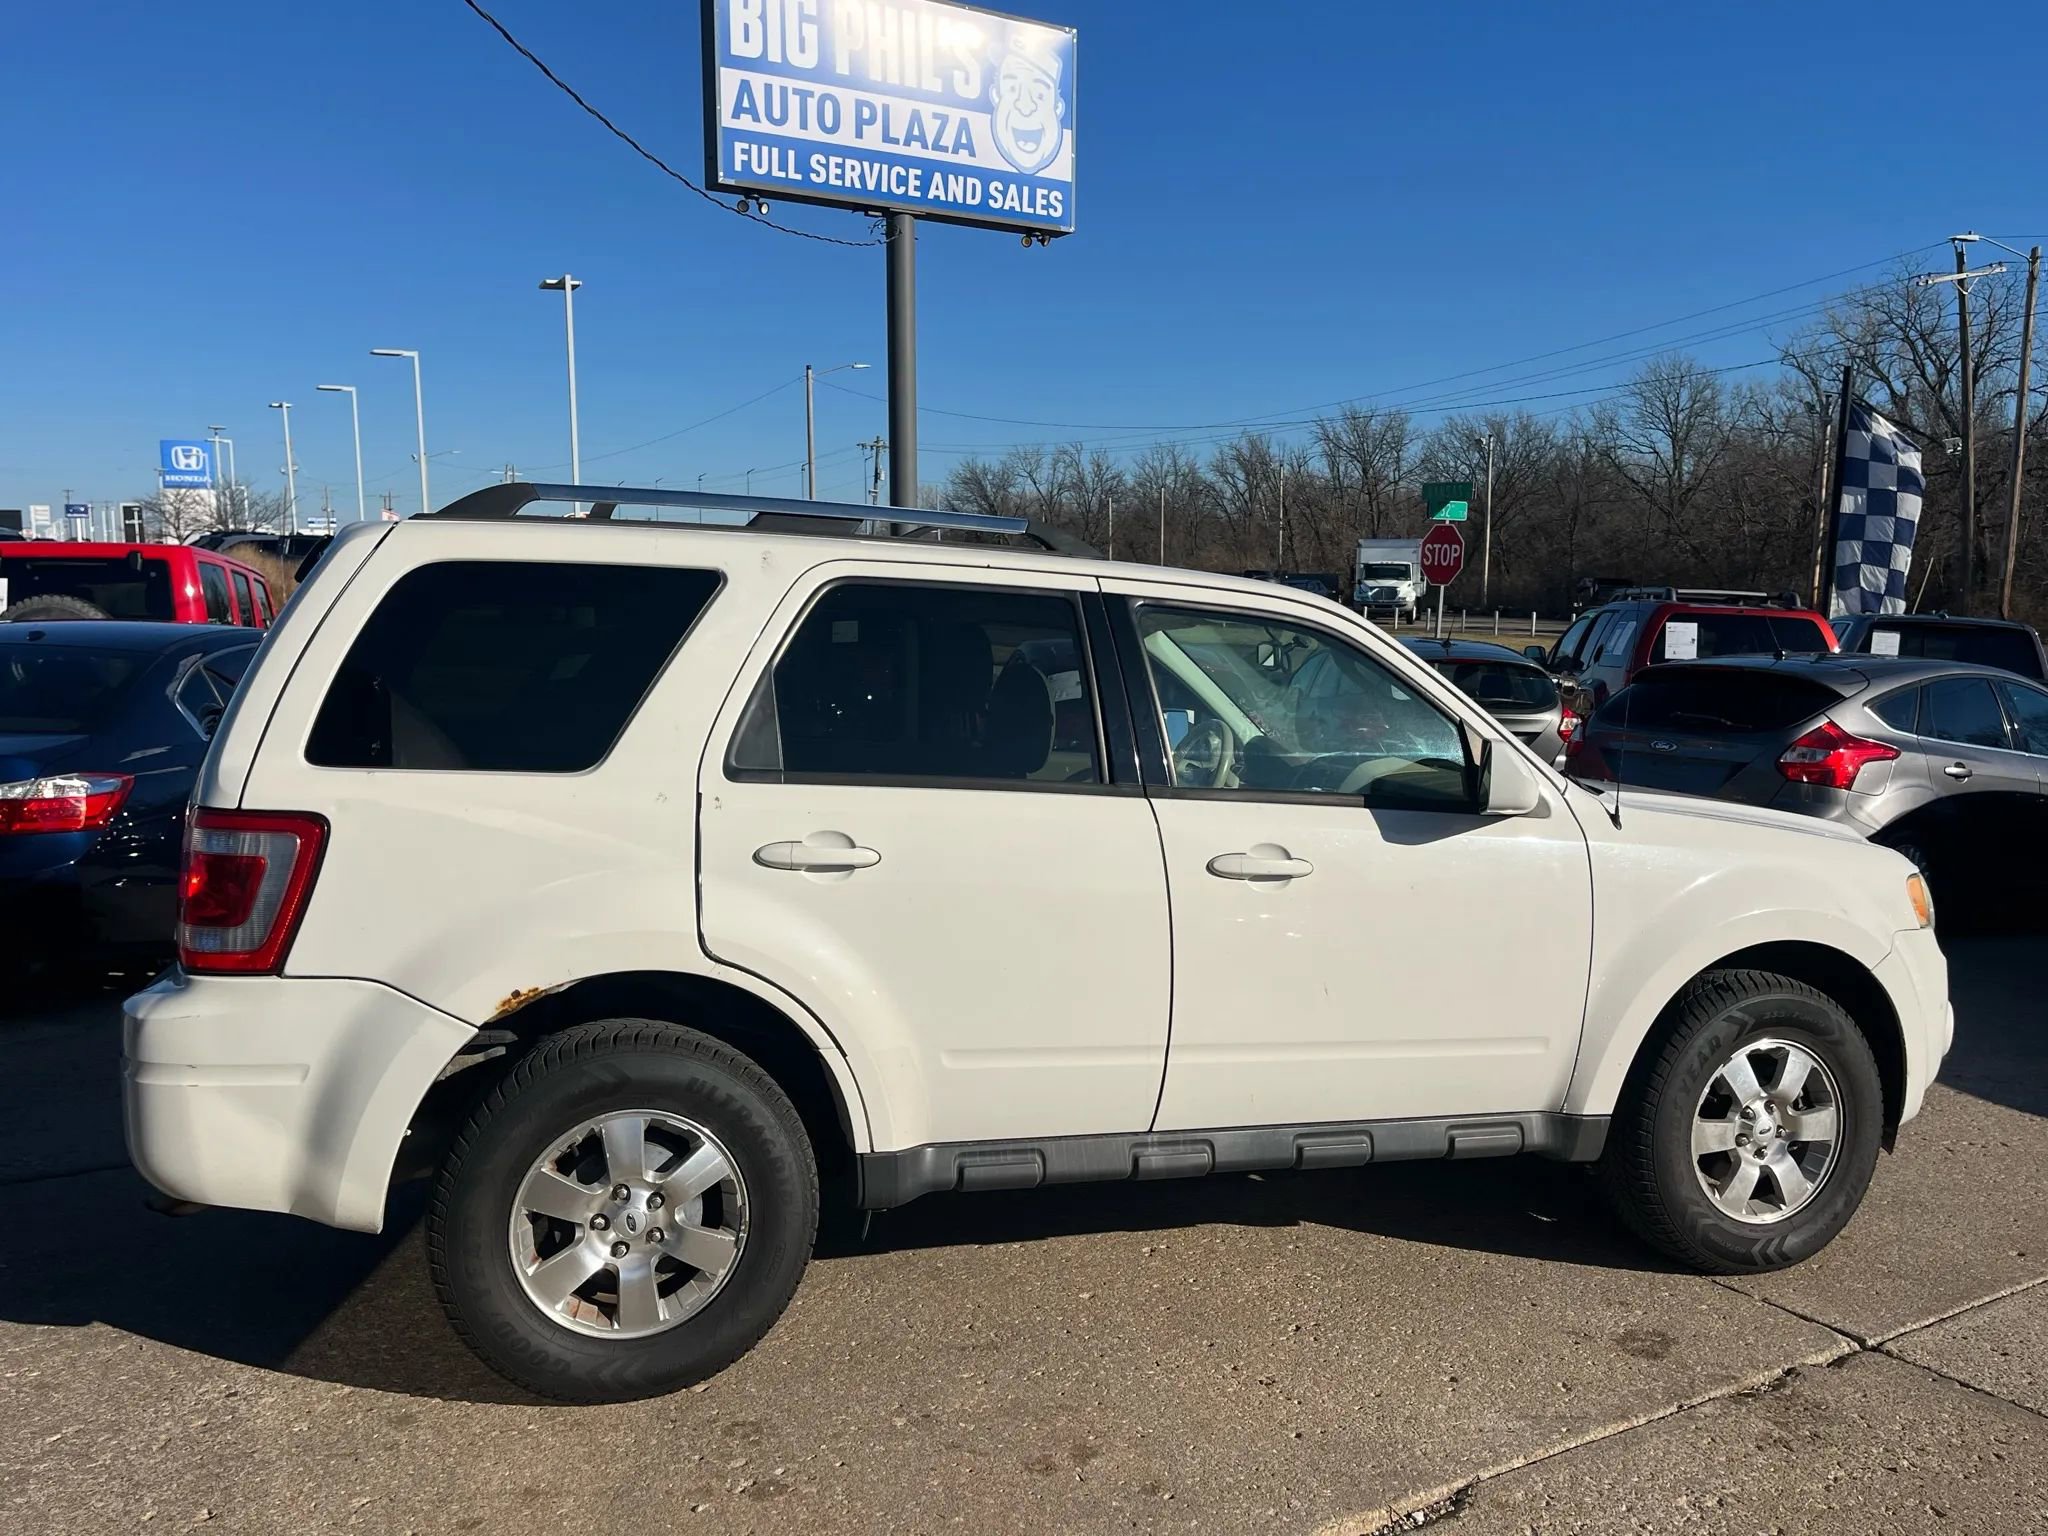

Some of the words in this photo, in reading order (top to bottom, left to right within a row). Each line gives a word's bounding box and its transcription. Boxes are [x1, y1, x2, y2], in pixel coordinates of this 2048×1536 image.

[730, 0, 819, 69] BIG
[731, 79, 841, 135] AUTO
[854, 98, 977, 158] PLAZA
[733, 141, 802, 181] FULL
[809, 153, 922, 199] SERVICE
[927, 172, 981, 206] AND
[988, 181, 1064, 218] SALES
[165, 475, 210, 483] HONDA
[1423, 543, 1460, 566] STOP
